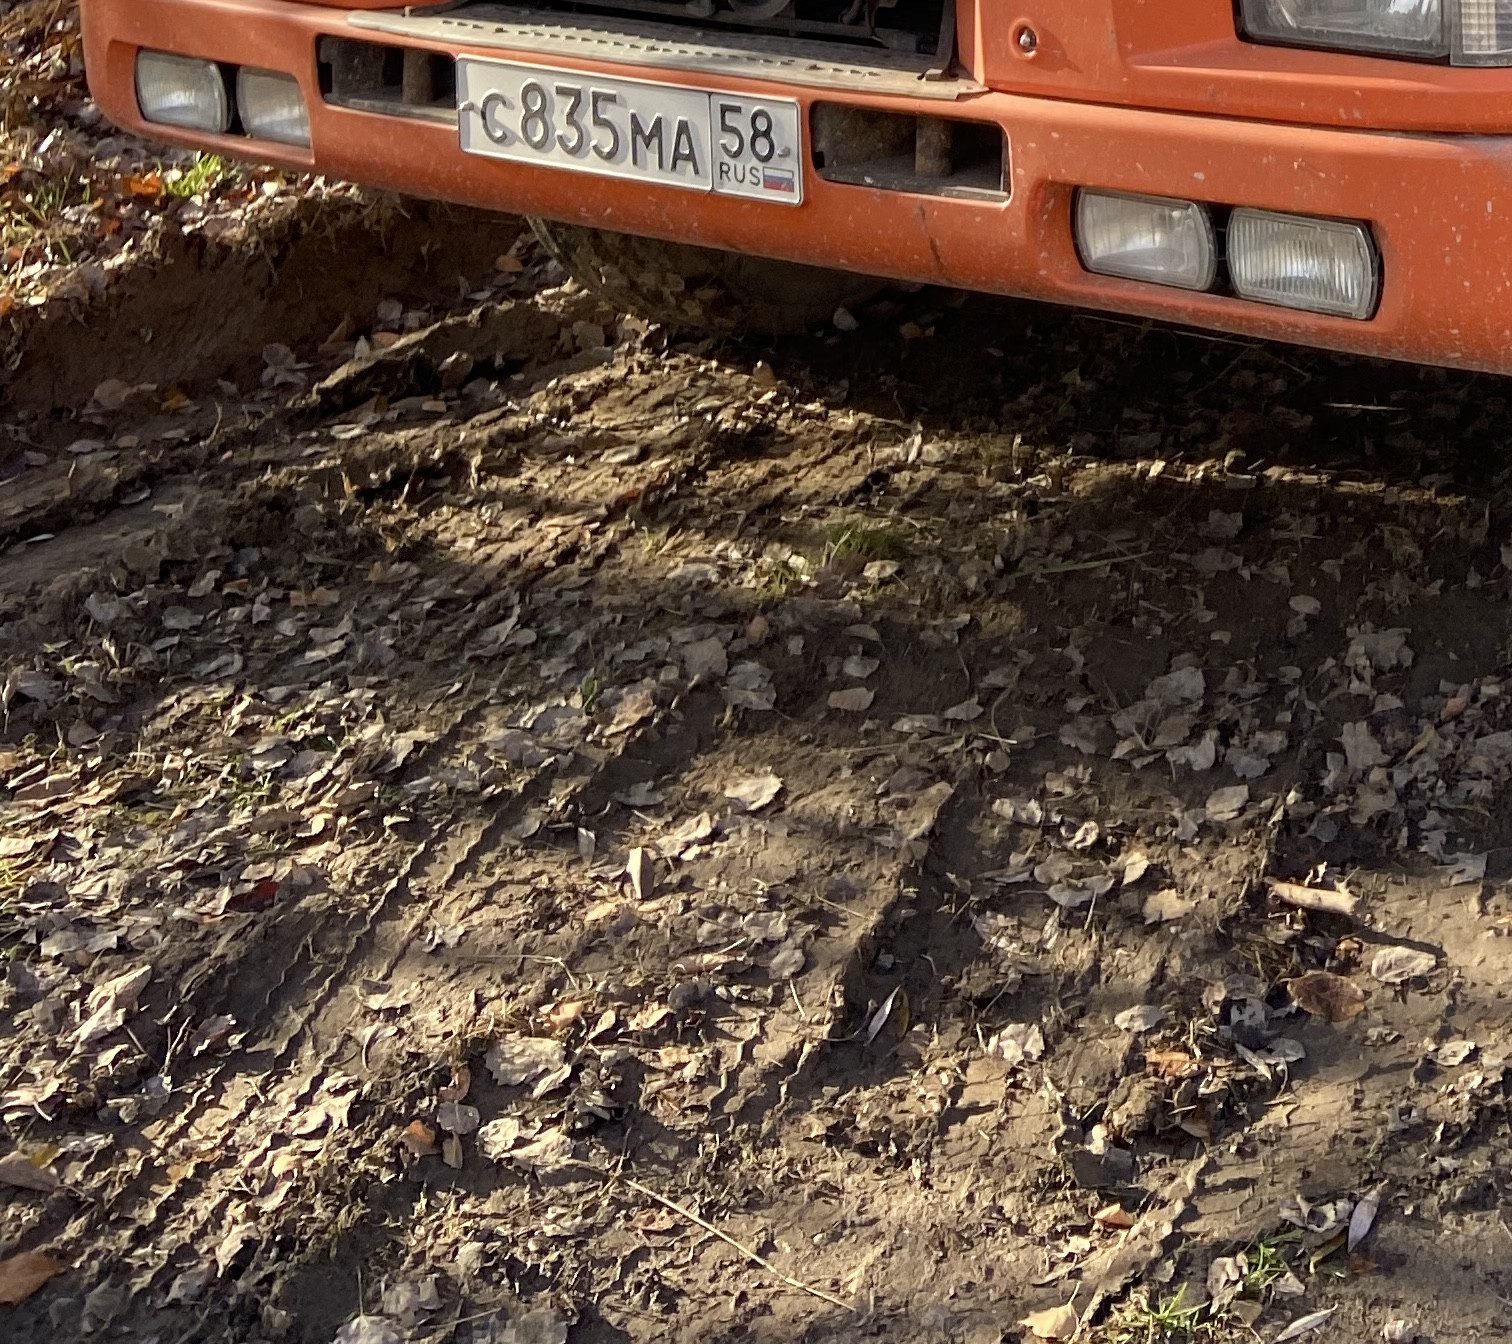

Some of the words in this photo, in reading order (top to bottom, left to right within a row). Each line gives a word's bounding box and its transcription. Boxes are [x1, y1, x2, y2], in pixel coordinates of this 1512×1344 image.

[480, 78, 700, 176] С835МА
[718, 103, 776, 163] 58
[719, 161, 761, 187] RUS
